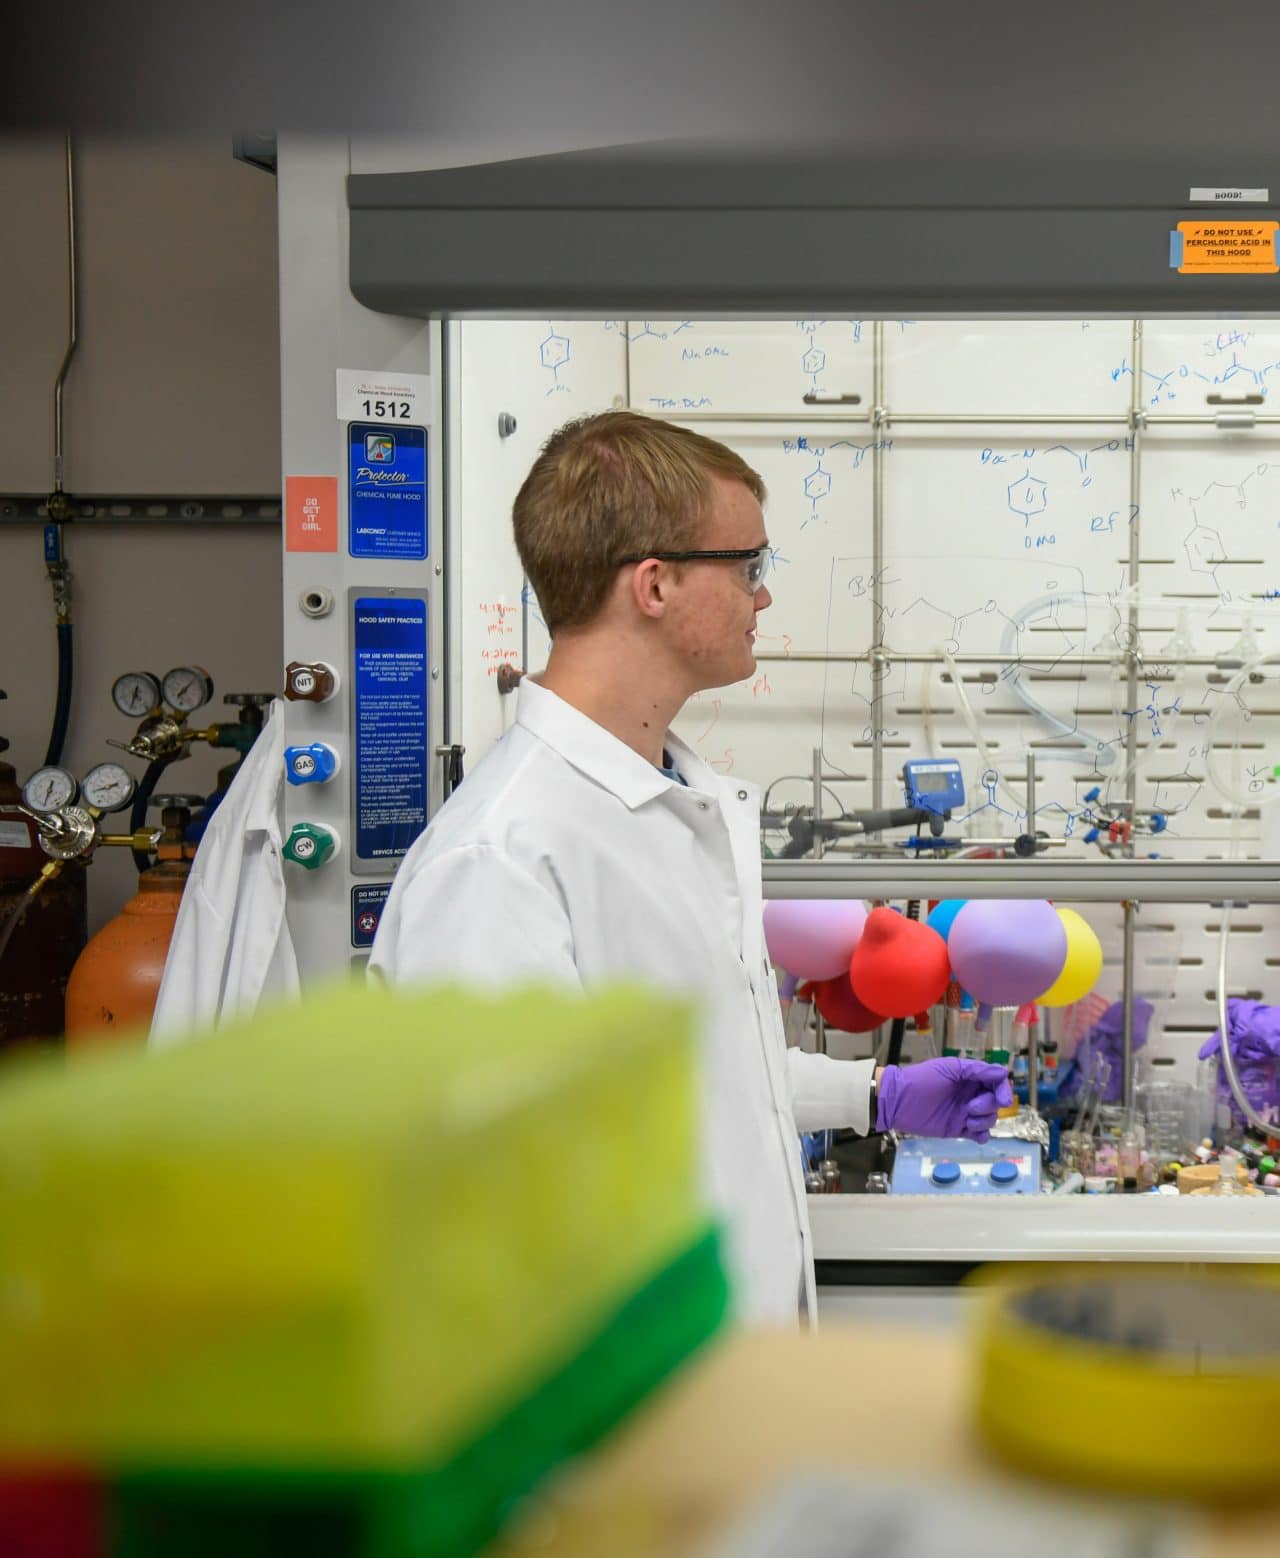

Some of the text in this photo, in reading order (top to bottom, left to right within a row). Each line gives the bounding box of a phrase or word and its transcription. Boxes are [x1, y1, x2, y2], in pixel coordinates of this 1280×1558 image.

[1186, 239, 1239, 247] PERCHLORIC
[362, 400, 411, 419] 1512
[356, 467, 407, 482] Protector
[356, 490, 422, 501] CHEMICAL FUME HOOD
[306, 498, 318, 506] GO
[303, 506, 320, 514] GET
[307, 514, 316, 522] IT
[302, 522, 322, 531] GIRL
[297, 677, 312, 688] NIT
[295, 758, 315, 771] GAS
[297, 841, 313, 853] CW
